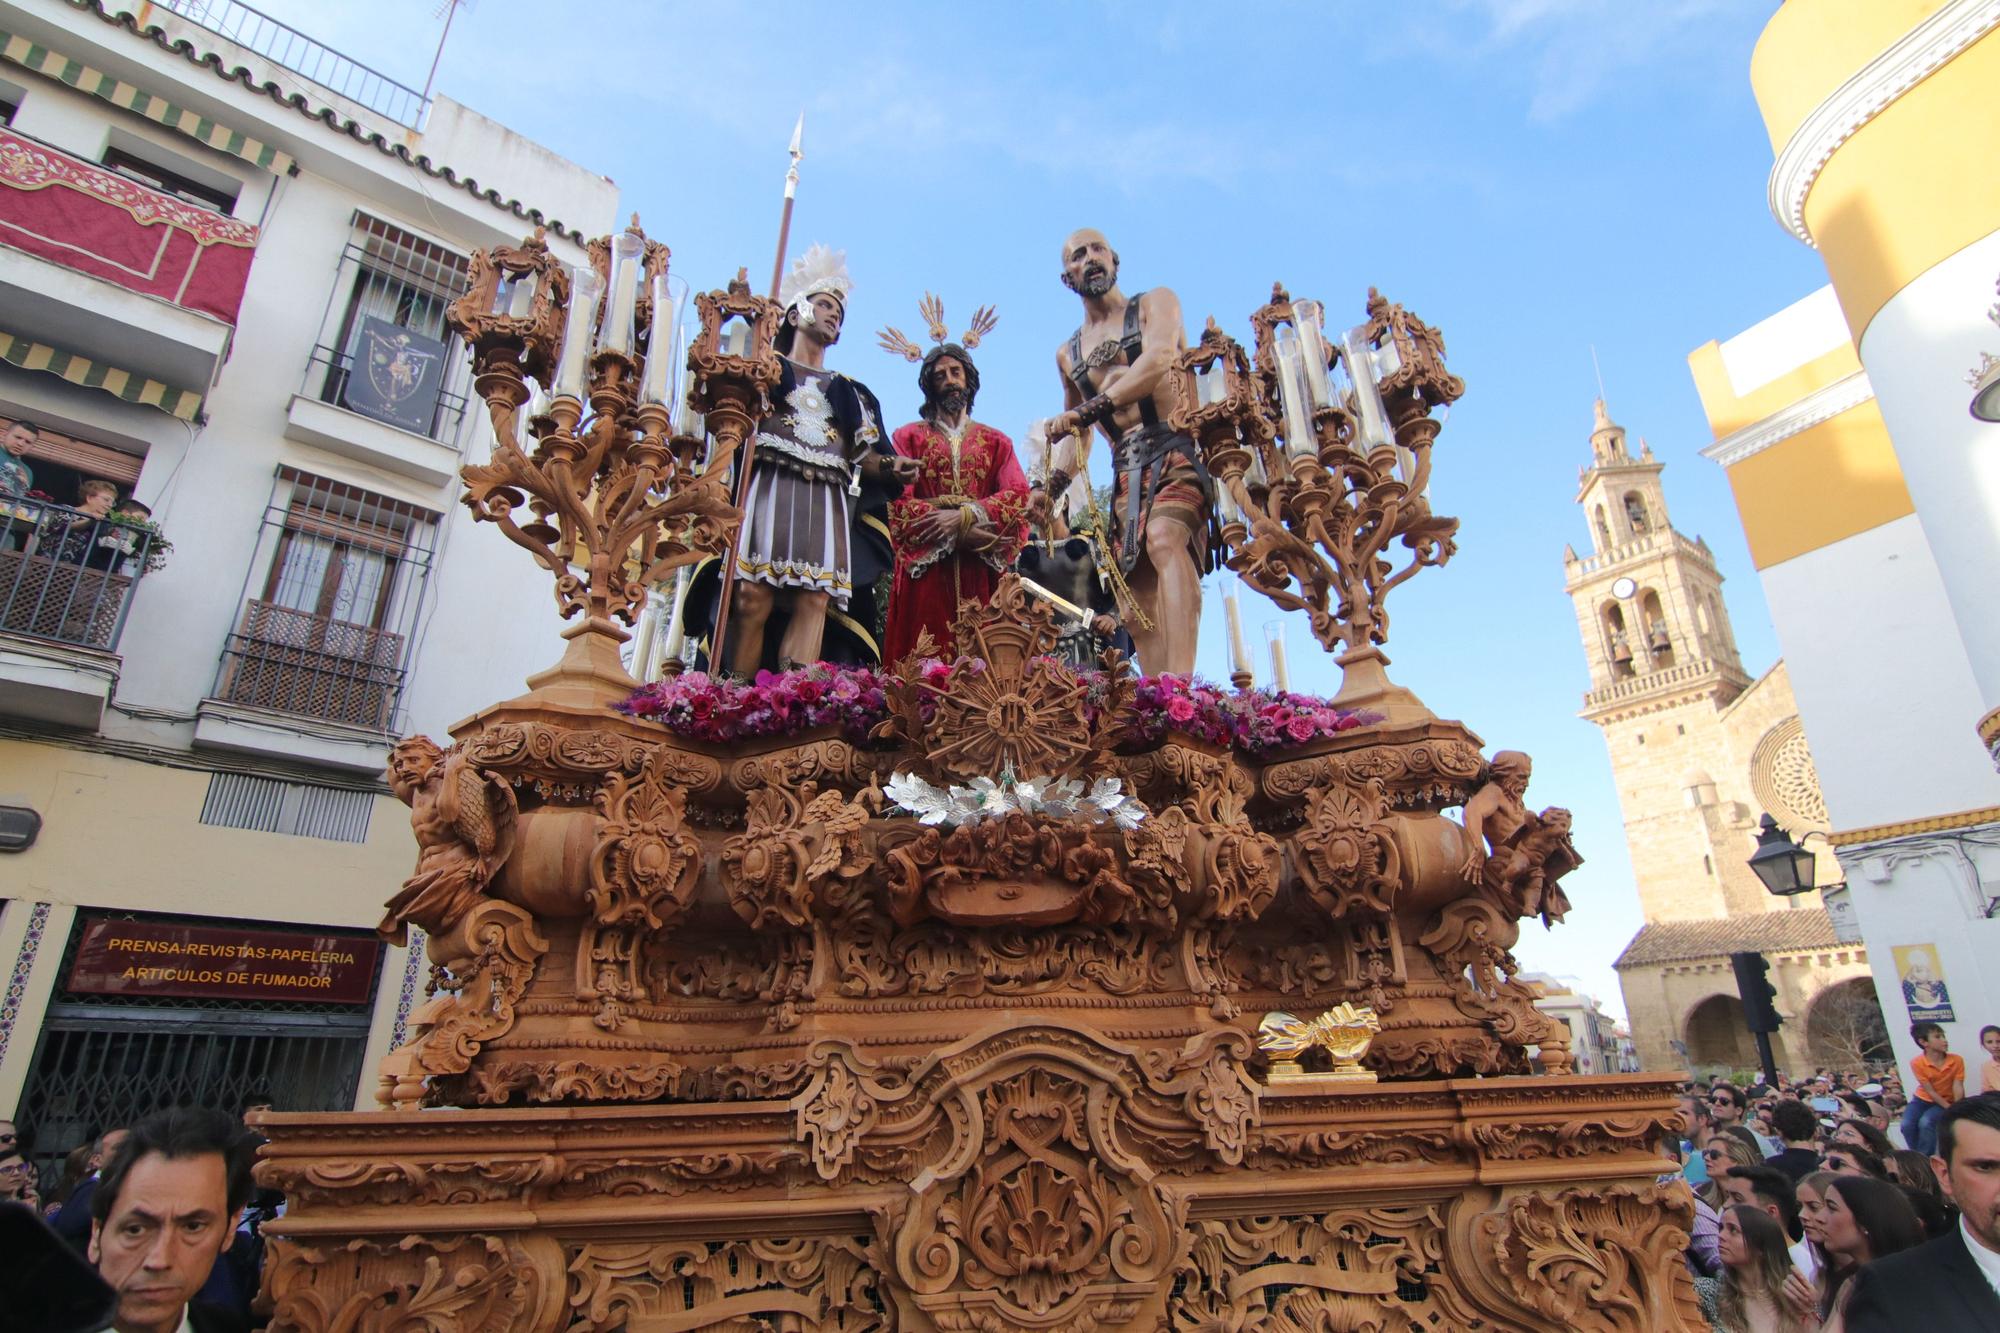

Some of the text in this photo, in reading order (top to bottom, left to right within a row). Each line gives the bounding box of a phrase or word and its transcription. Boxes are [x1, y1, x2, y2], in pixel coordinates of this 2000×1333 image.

[108, 938, 354, 964] PRENSA-REVISTAS-PAPELERIA
[122, 966, 332, 989] ARTICULOS DE FUMADOR
